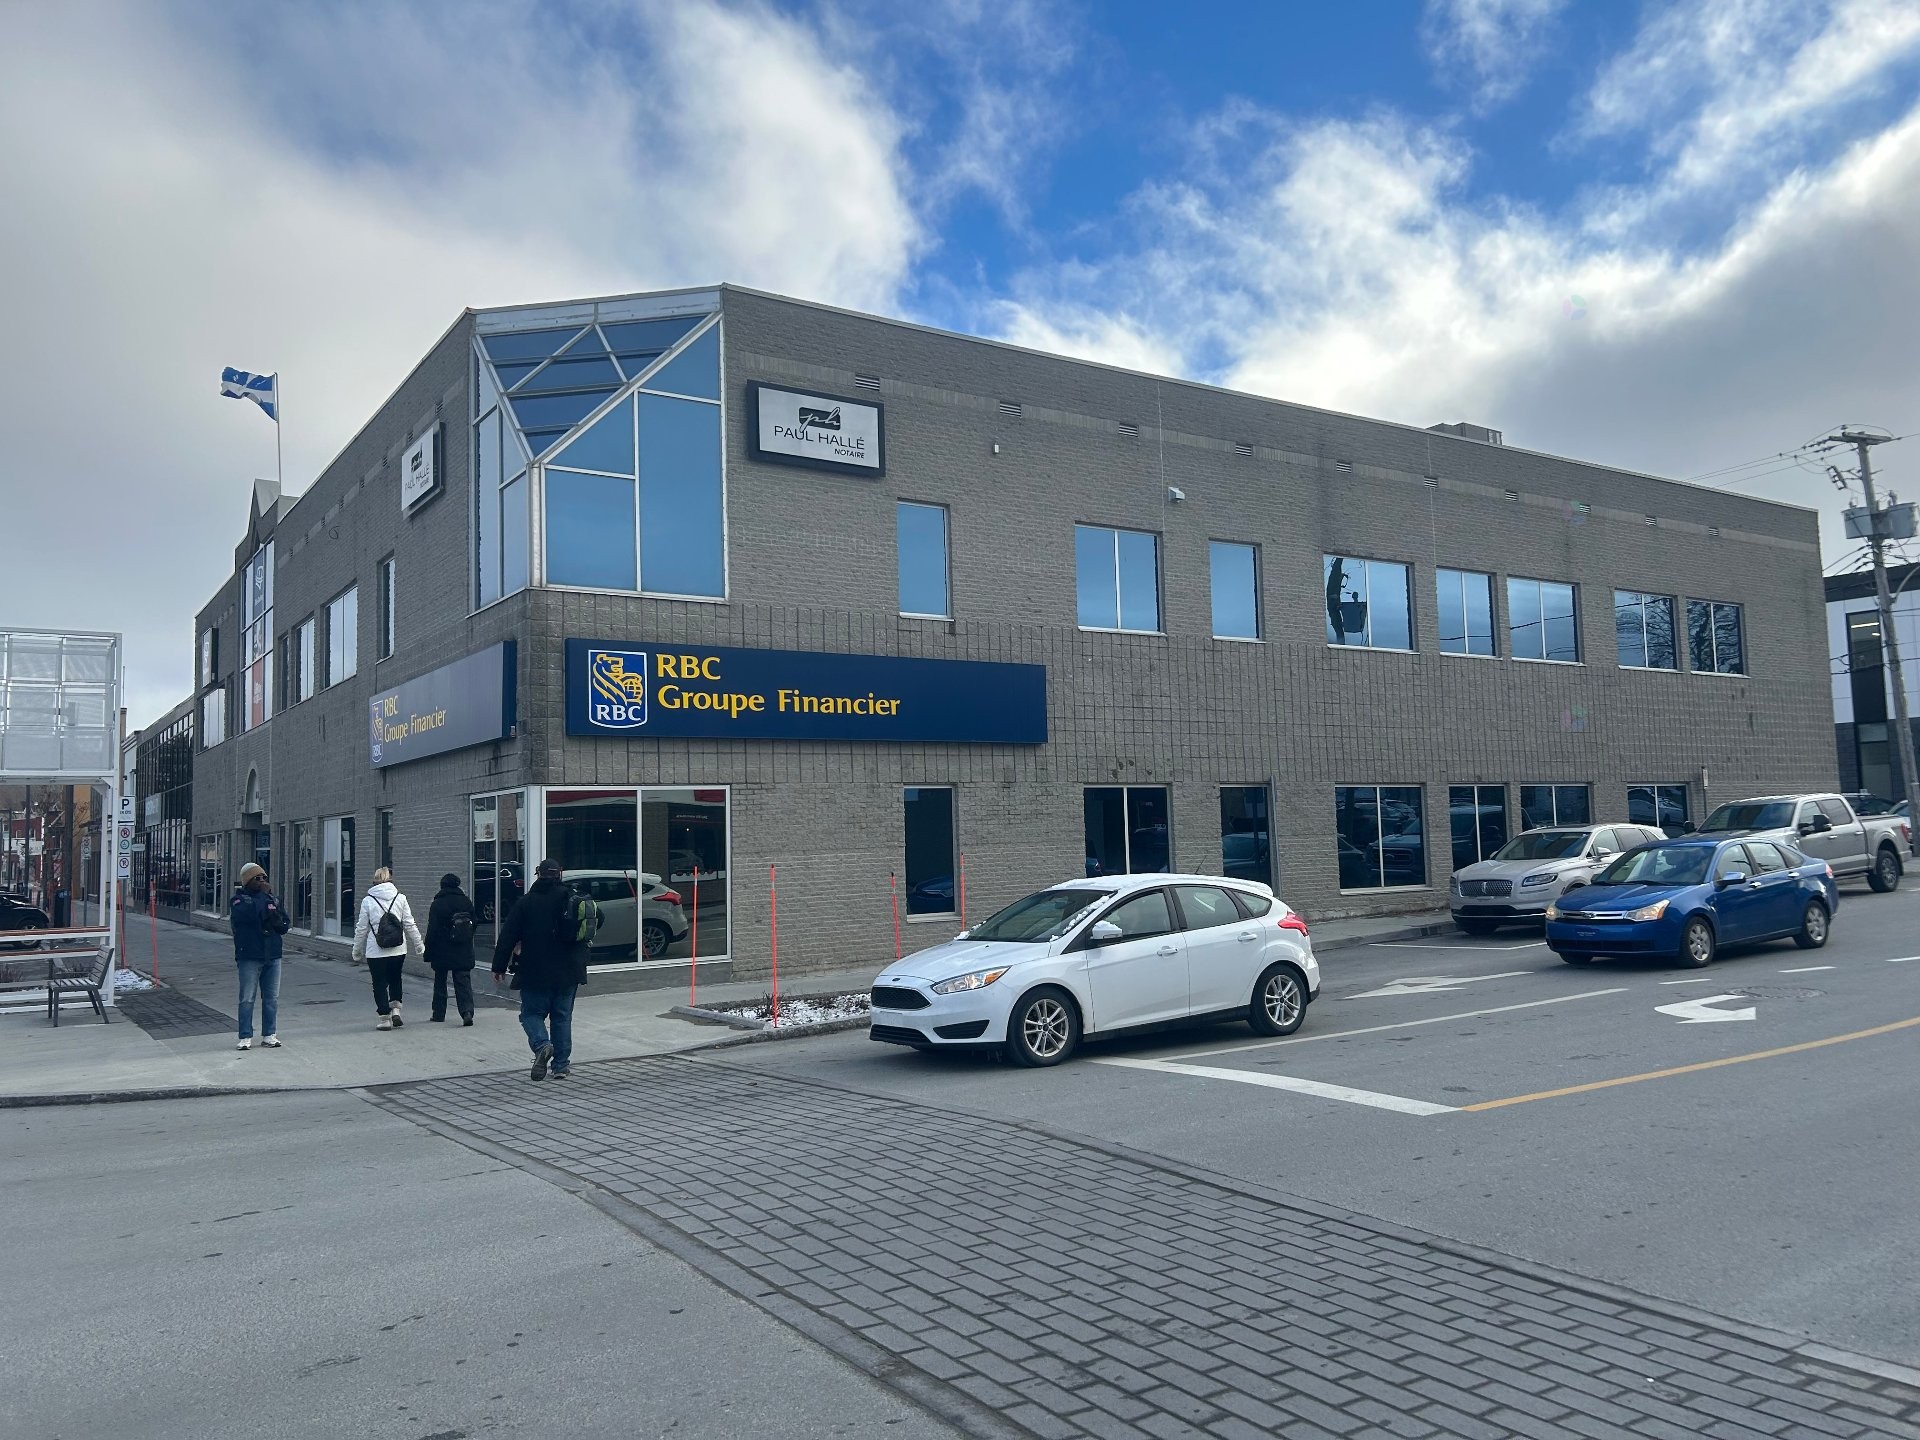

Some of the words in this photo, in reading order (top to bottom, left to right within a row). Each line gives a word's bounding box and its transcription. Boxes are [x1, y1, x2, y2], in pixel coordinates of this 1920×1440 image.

[774, 425, 813, 442] PAUL
[818, 432, 865, 450] HALLÉ
[834, 448, 865, 459] NOTAIRE
[656, 653, 721, 680] RBC
[384, 695, 399, 718] RBC
[595, 703, 641, 721] RBC
[657, 685, 765, 718] Groupe
[778, 689, 900, 715] Financier
[384, 721, 409, 745] Groupe
[410, 706, 447, 735] Financier
[121, 798, 130, 810] P
